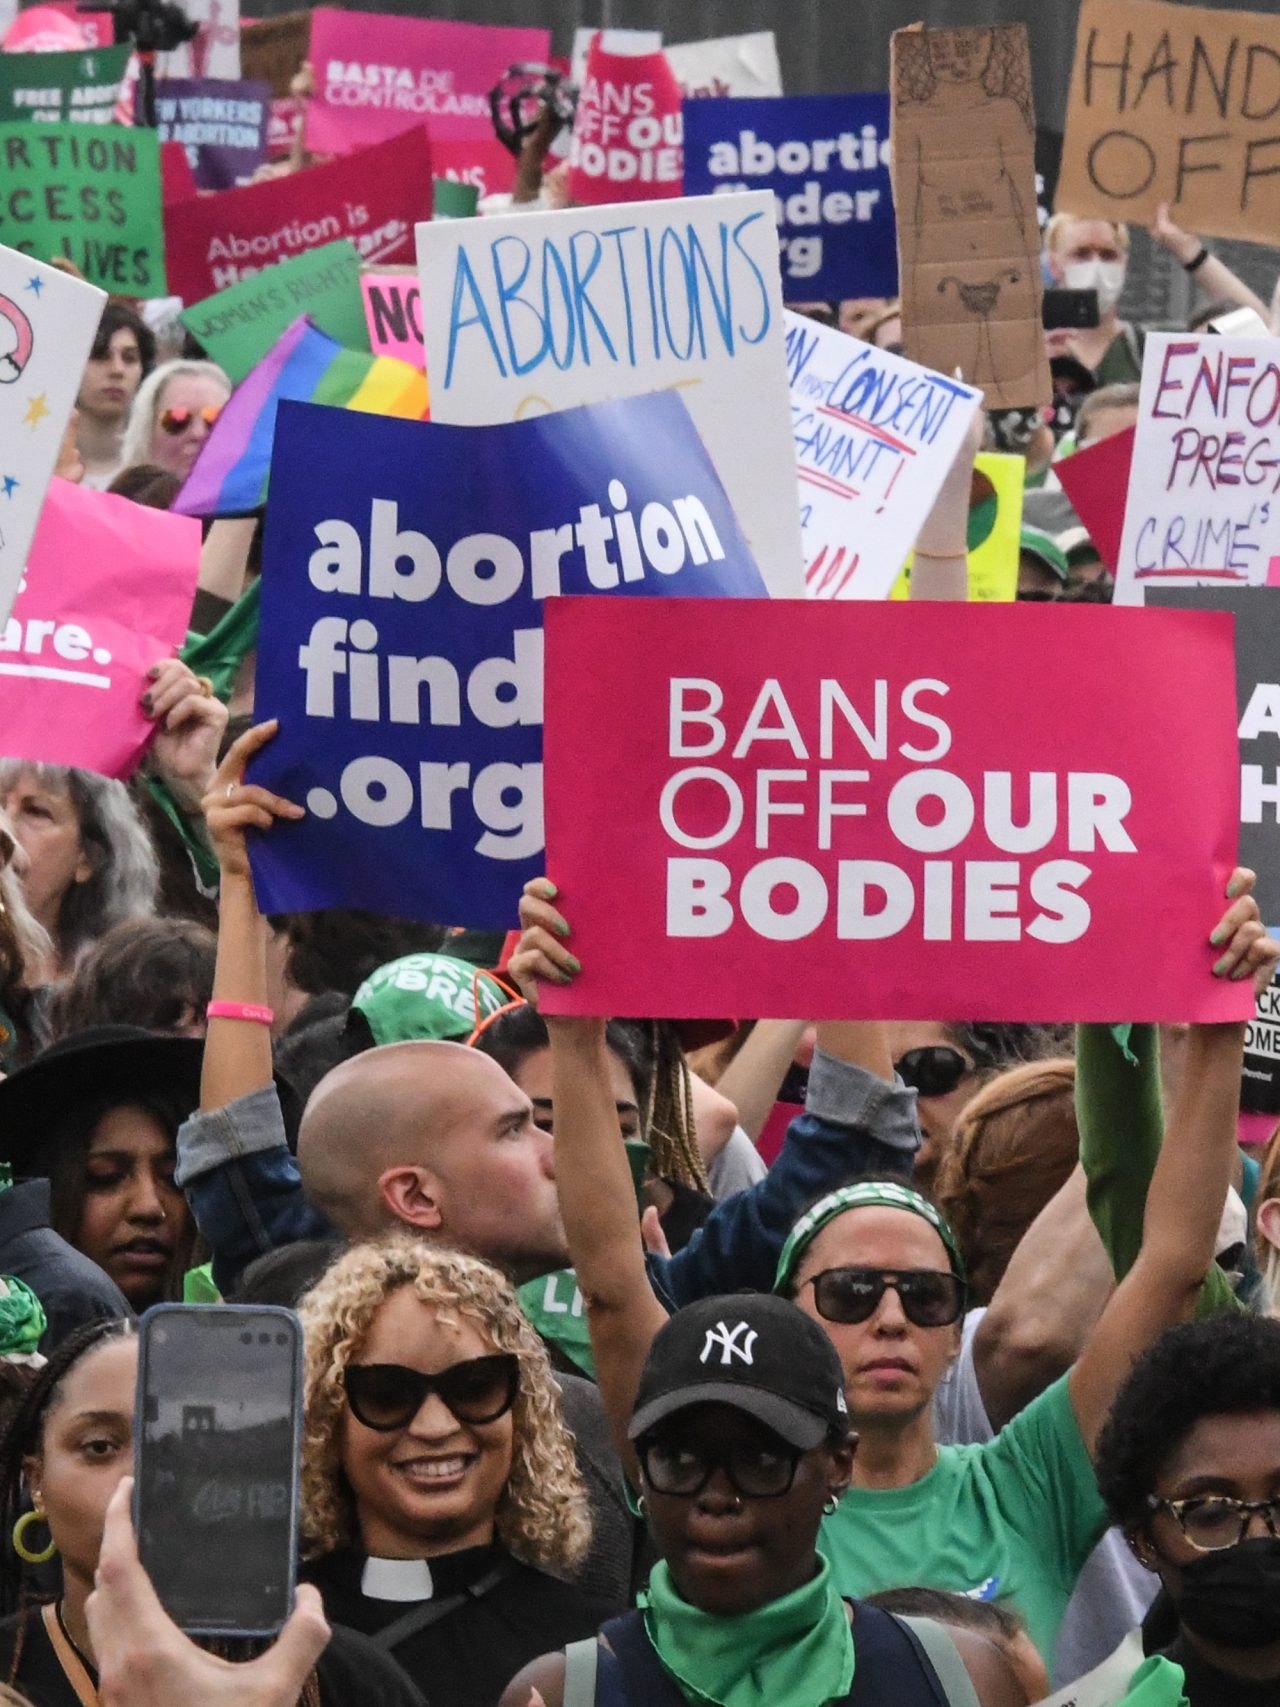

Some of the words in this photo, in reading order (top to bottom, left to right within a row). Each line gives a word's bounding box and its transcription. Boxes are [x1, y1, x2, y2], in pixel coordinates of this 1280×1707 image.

[326, 59, 414, 89] BASTA
[571, 135, 684, 183] ODIE
[0, 186, 128, 225] CESS
[207, 214, 341, 262] Abortion
[344, 203, 370, 226] is
[346, 218, 408, 256] are.
[444, 211, 772, 389] ABORTIONS
[825, 349, 975, 446] CONSENT
[307, 478, 726, 606] abortion
[1135, 516, 1260, 571] CRIME
[1248, 502, 1271, 524] IS
[299, 616, 544, 728] find
[667, 677, 953, 762] BANS
[306, 755, 546, 861] .org
[659, 766, 871, 850] OFF
[886, 768, 1138, 854] OUR
[665, 856, 1093, 944] BODIES
[699, 1320, 759, 1366] NY
